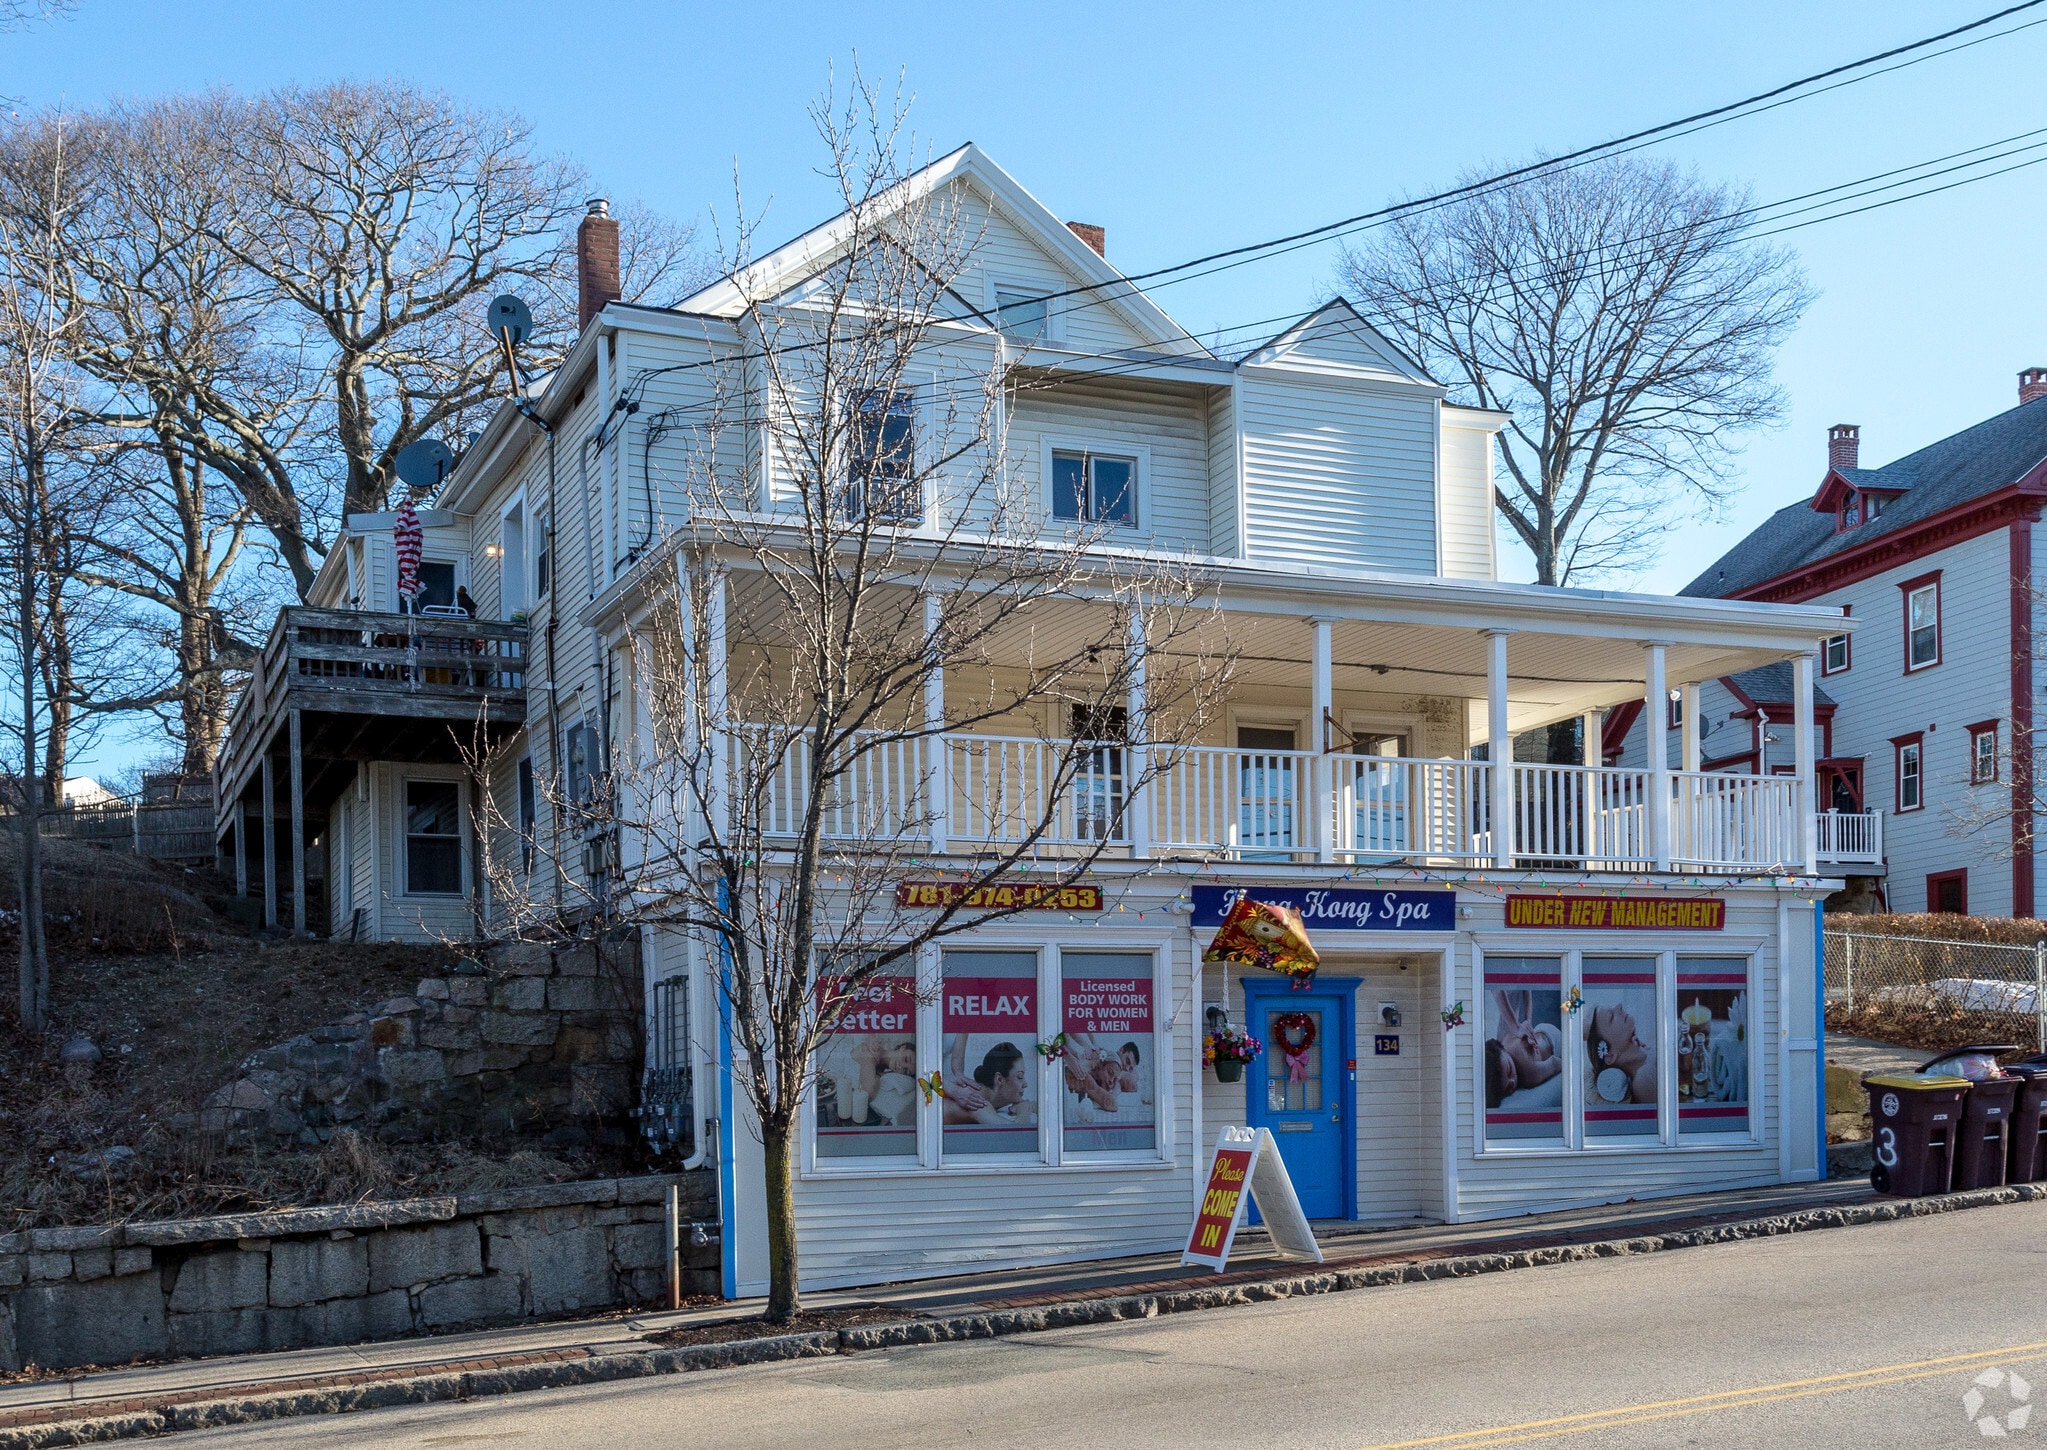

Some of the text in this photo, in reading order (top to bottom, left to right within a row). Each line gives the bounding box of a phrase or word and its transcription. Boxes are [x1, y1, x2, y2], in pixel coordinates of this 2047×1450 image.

[1300, 891, 1372, 927] Kong
[1379, 892, 1430, 927] Spa
[1510, 899, 1720, 927] UNDER NEW MANAGEMENT
[1080, 980, 1135, 992] Licensed
[949, 995, 1030, 1016] RELAX
[1069, 994, 1147, 1005] BODY WORK
[1068, 1007, 1148, 1018] FOR WOMEN
[1087, 1020, 1130, 1032] & MEN
[1376, 1039, 1398, 1051] 134
[1876, 1126, 1899, 1167] 3
[1212, 1157, 1245, 1182] Please
[1202, 1188, 1239, 1218] COME
[1200, 1223, 1222, 1248] IN
